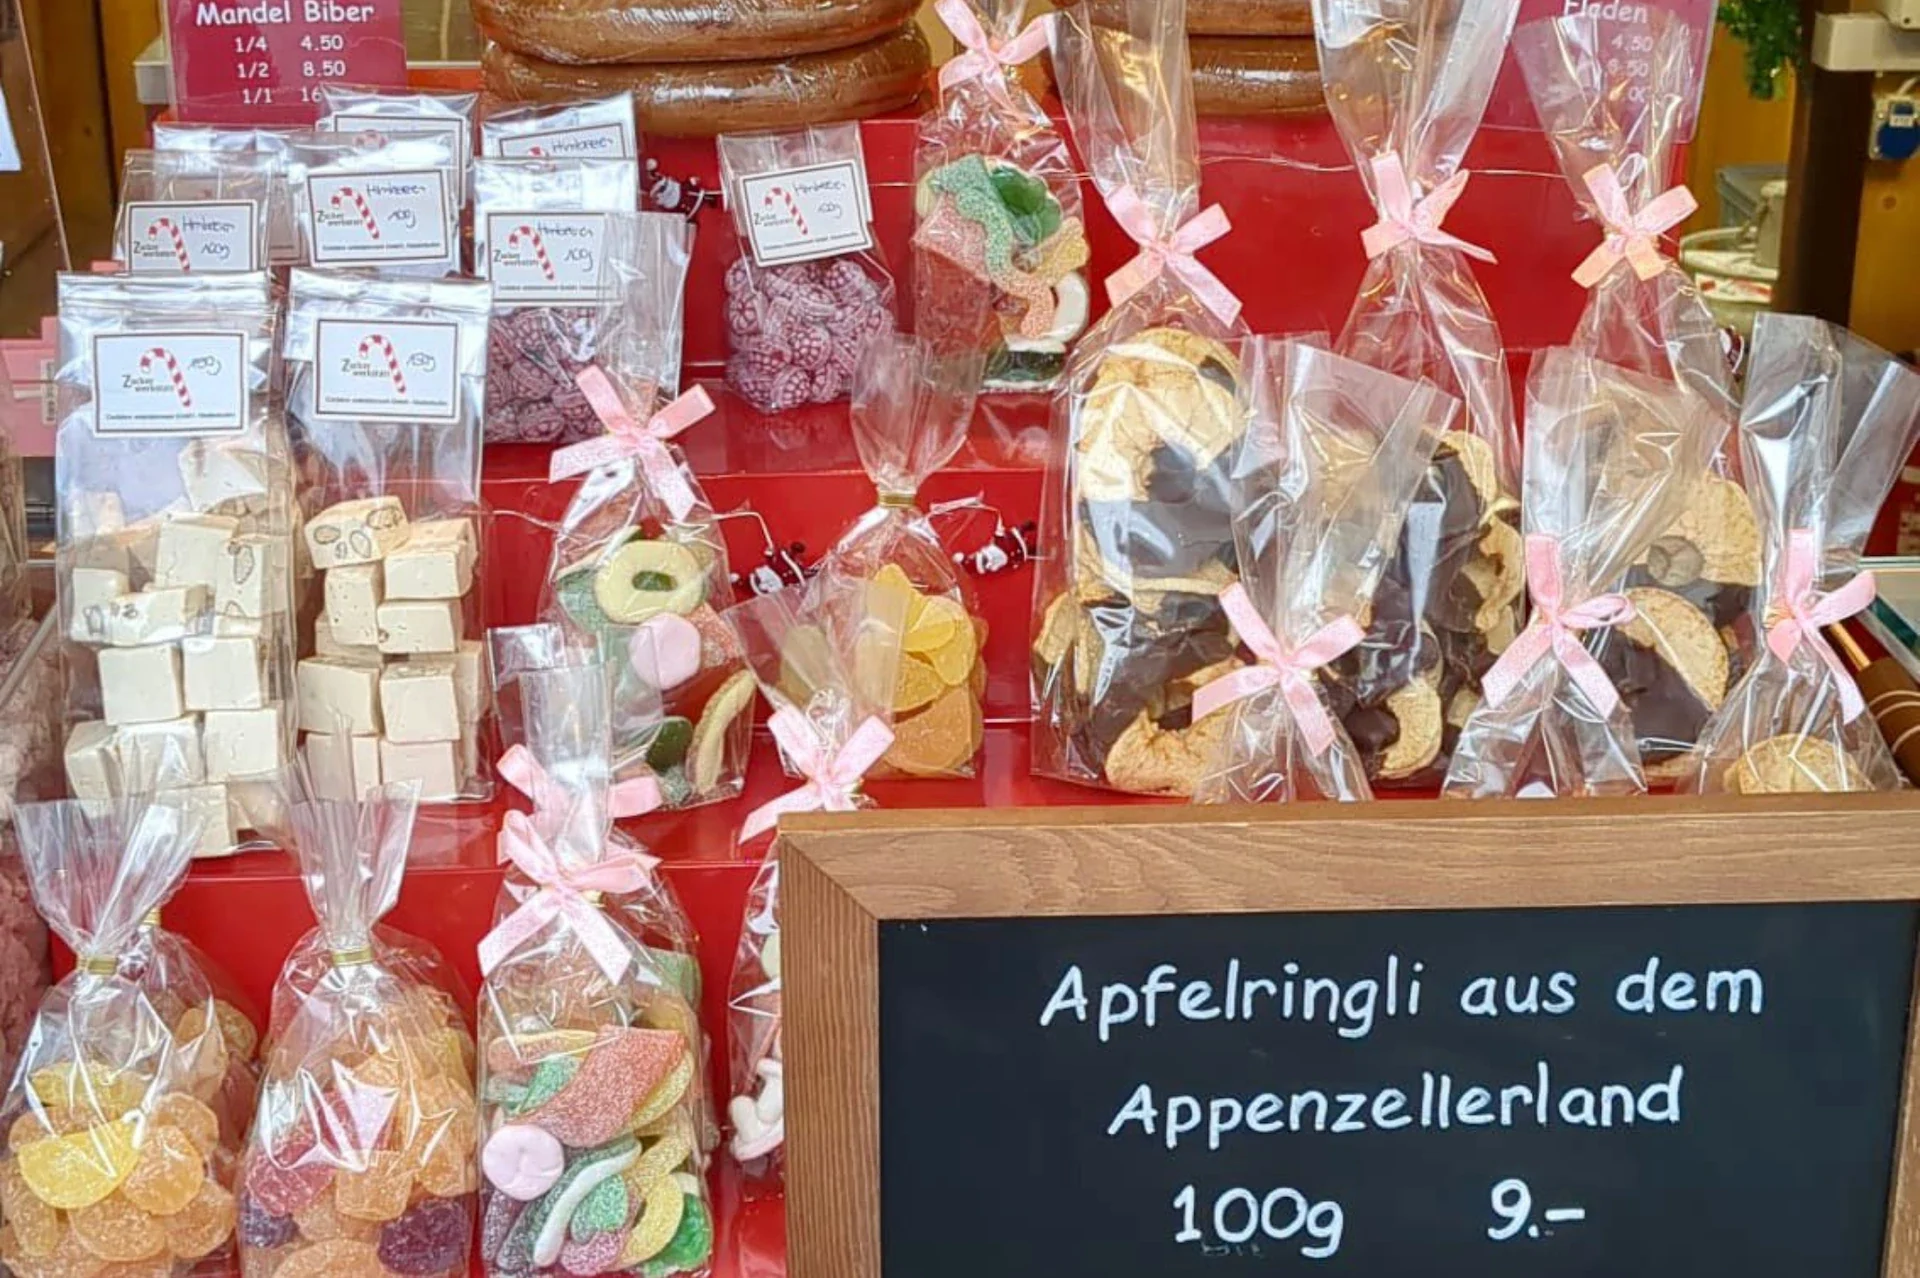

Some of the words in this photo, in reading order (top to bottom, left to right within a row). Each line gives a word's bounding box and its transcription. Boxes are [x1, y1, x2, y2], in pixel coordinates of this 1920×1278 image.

[195, 0, 291, 27] Mandel
[304, 0, 375, 24] Biber
[234, 36, 268, 53] 1/4
[301, 35, 344, 51] 4.50
[237, 62, 269, 79] 1/2
[303, 60, 346, 77] 8.50
[243, 87, 272, 104] 1/1
[1040, 954, 1427, 1043] Apfelringli
[1460, 971, 1578, 1017] aus
[1616, 956, 1765, 1015] dem
[1107, 1061, 1685, 1152] Appenzellerland
[1172, 1184, 1345, 1260] 100g
[1486, 1177, 1588, 1242] 9.-
